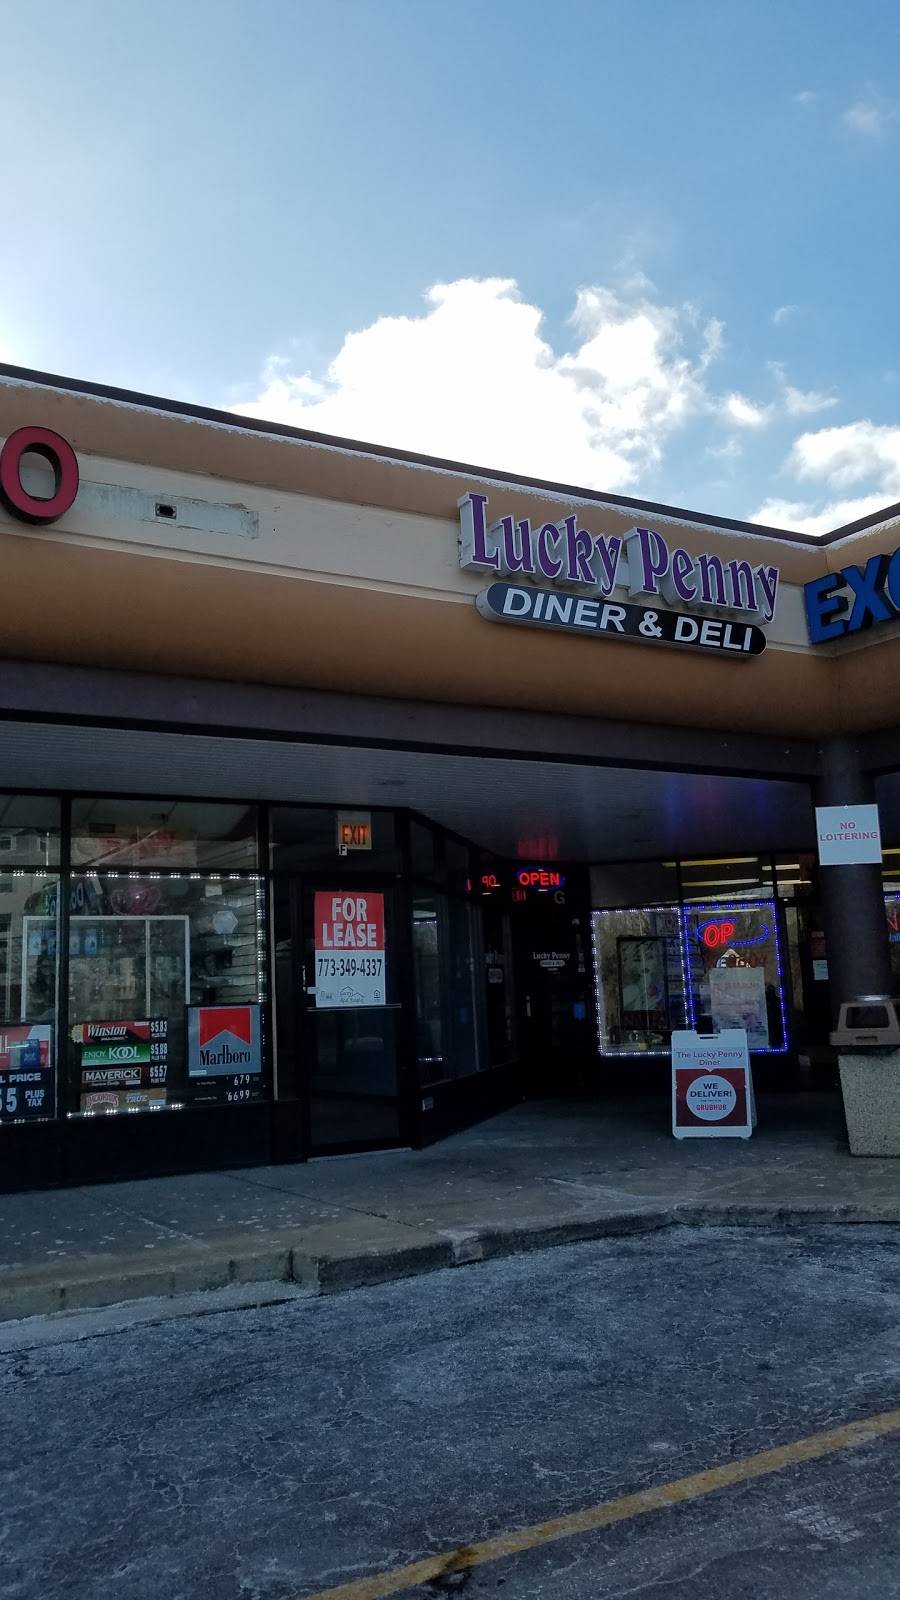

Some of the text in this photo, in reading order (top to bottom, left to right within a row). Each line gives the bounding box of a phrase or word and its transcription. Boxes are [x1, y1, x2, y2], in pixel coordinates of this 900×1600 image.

[467, 491, 780, 623] Lucky Penny
[803, 547, 900, 645] EX
[502, 588, 753, 651] DINER & DELI
[840, 821, 856, 830] NO
[342, 825, 368, 845] EXIT
[819, 831, 878, 841] LOITERING
[519, 872, 560, 886] OPEN
[554, 891, 565, 904] G
[331, 898, 368, 922] FOR
[322, 923, 377, 948] LEASE
[318, 958, 383, 977] 773-349-4337
[87, 1024, 128, 1037] Winston
[108, 1046, 141, 1060] KOOL
[200, 1044, 251, 1066] Marlboro
[693, 1051, 717, 1060] Lucky
[718, 1050, 743, 1059] Penny
[699, 1059, 721, 1067] Diner
[9, 1072, 41, 1083] PRICE
[85, 1068, 139, 1081] MAVERICK
[25, 1089, 45, 1099] PLUS
[690, 1090, 732, 1098] DELIVER!
[27, 1098, 42, 1107] TAX
